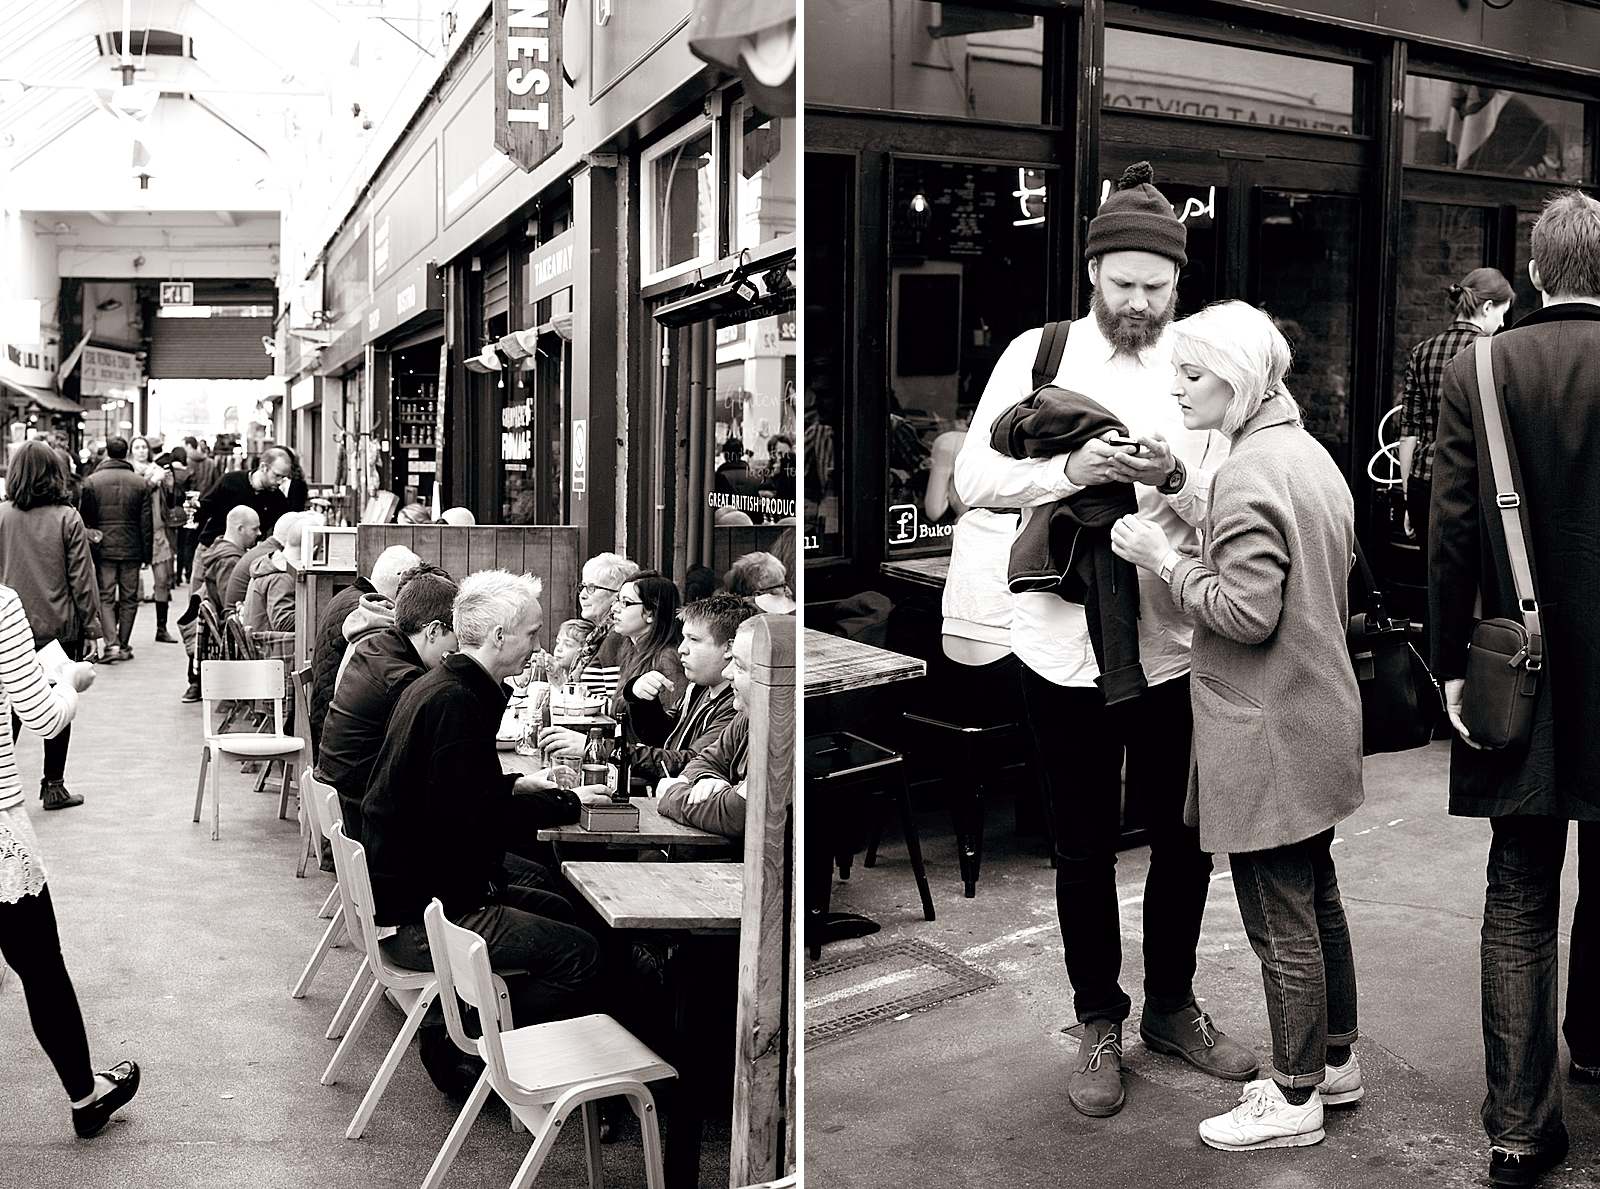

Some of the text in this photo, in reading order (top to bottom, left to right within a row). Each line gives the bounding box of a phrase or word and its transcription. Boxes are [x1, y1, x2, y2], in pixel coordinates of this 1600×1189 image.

[534, 244, 574, 288] TAKEAWAY
[708, 492, 730, 508] GREAT
[731, 494, 759, 512] BRITISH
